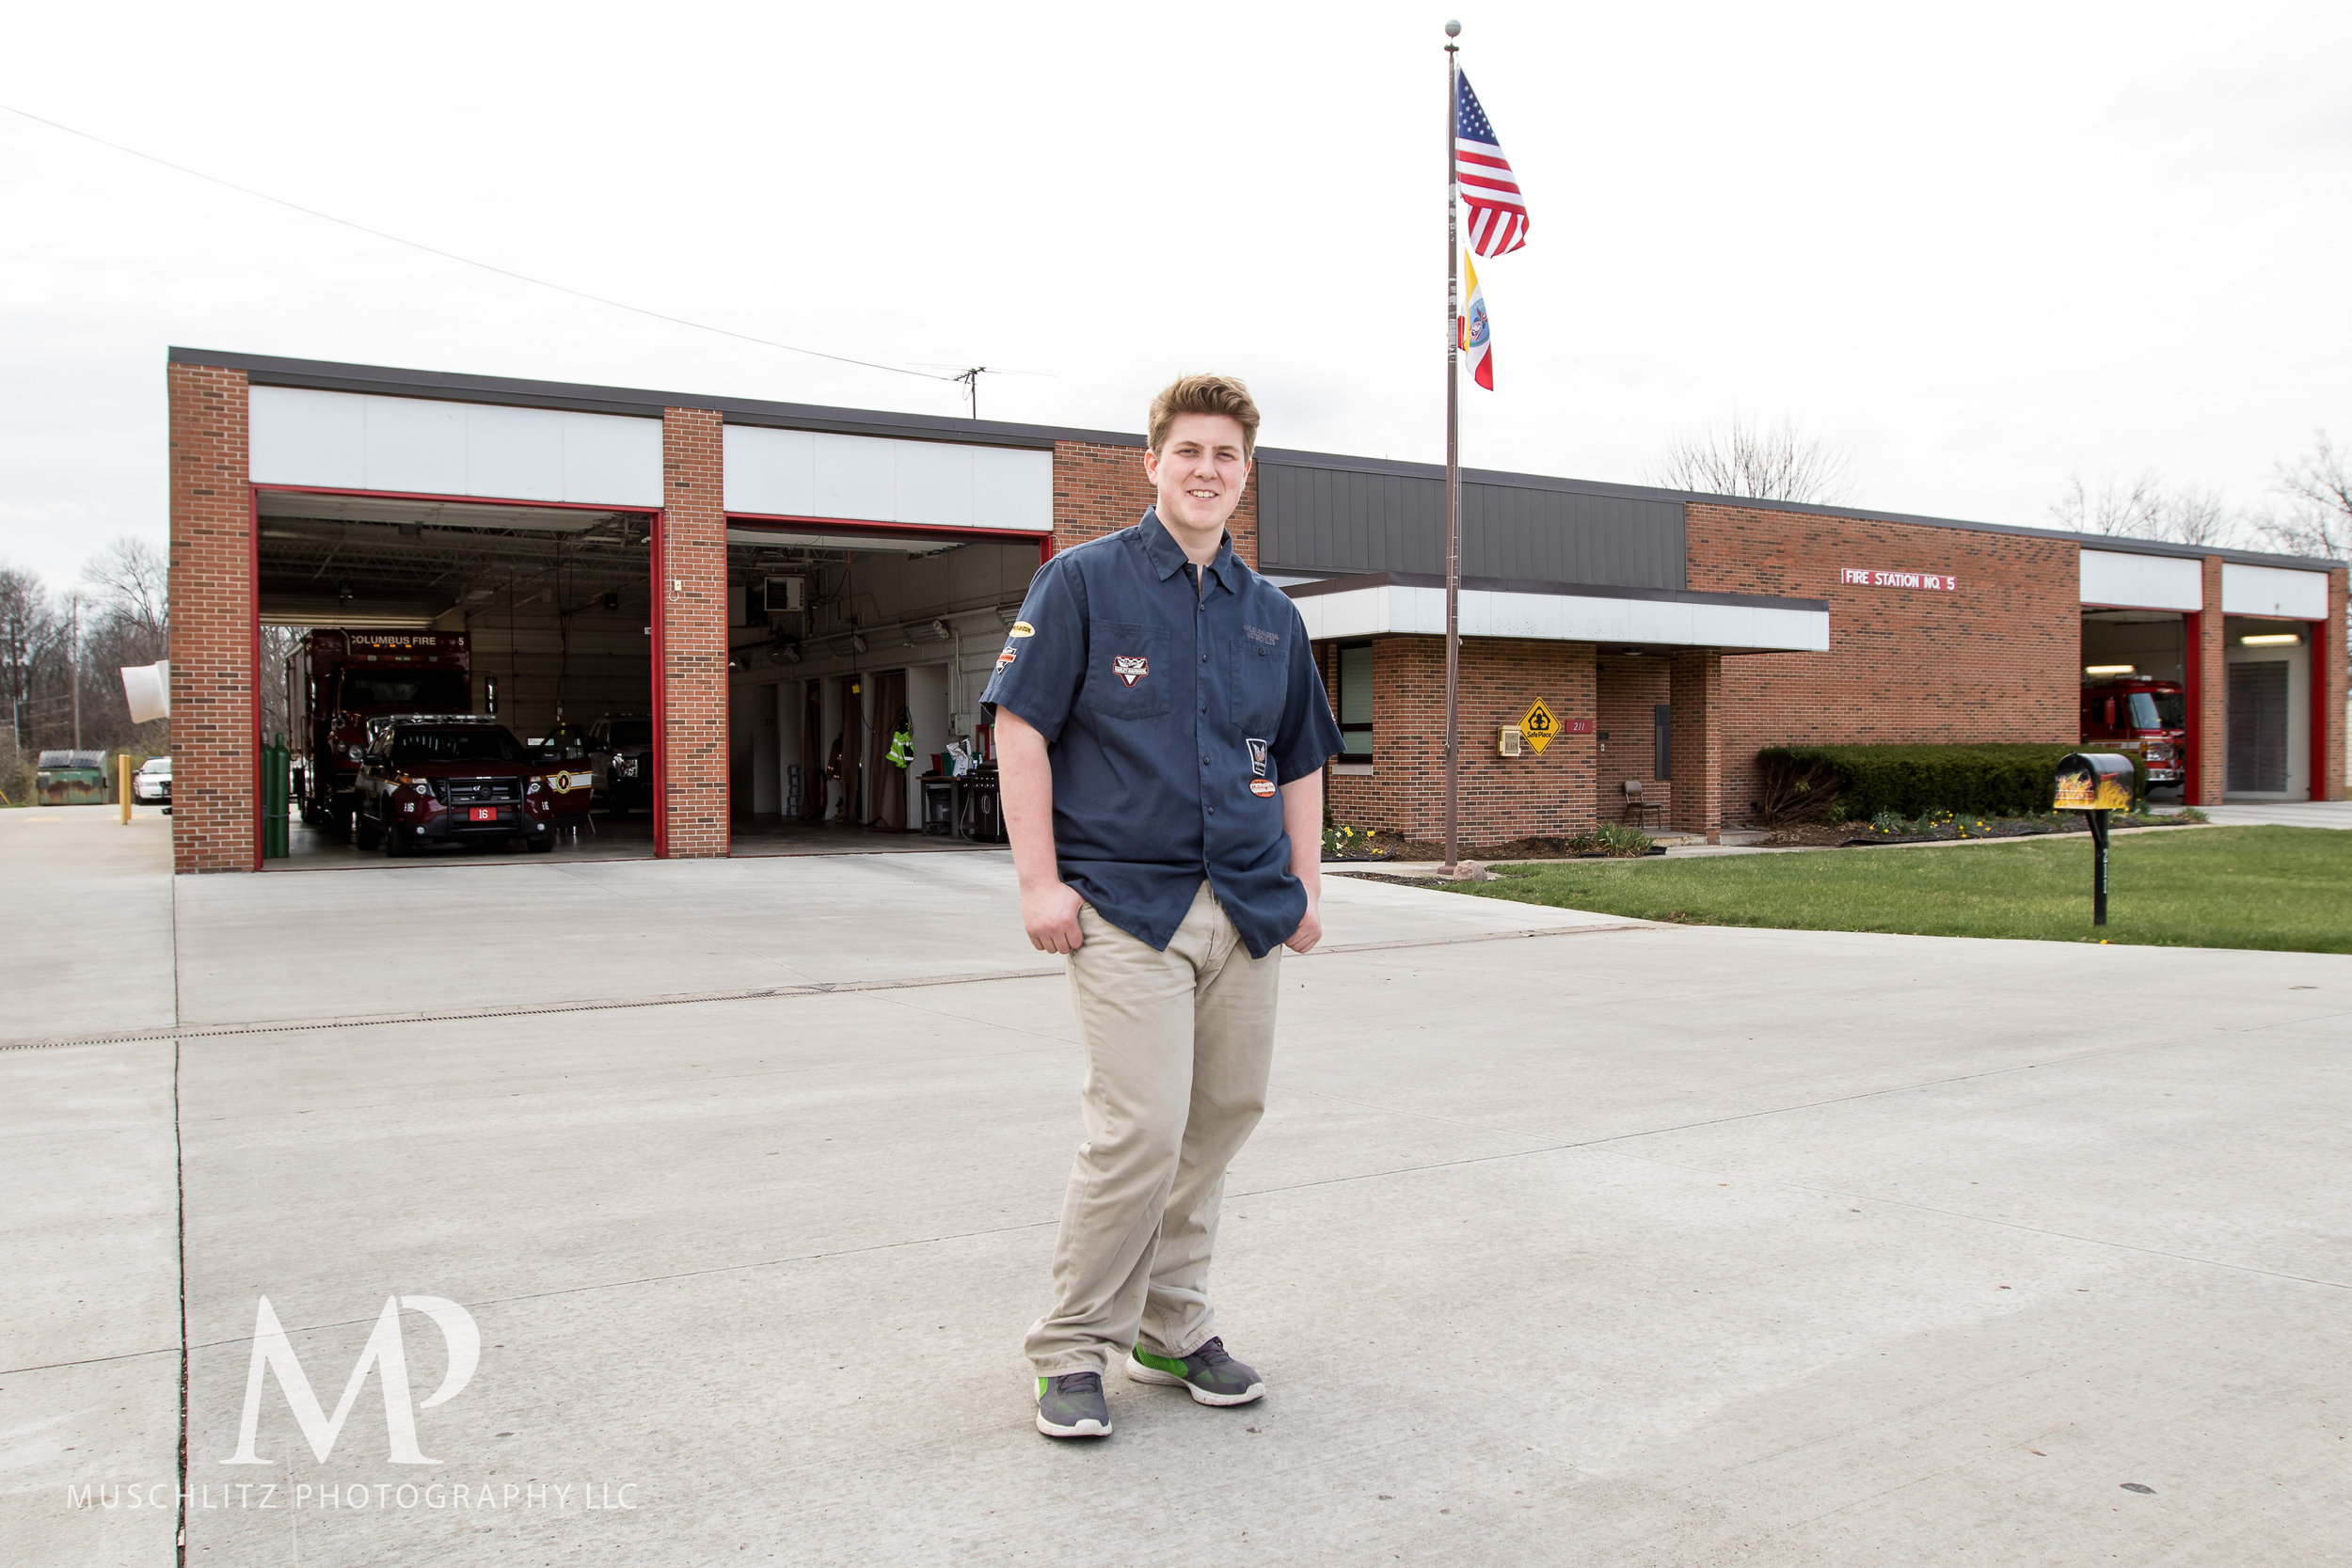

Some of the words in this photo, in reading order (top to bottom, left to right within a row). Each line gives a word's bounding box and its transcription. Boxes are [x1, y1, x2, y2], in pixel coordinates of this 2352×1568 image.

[1846, 570, 1868, 583] FIRE
[1874, 572, 1919, 588] STATION
[1924, 576, 1941, 590] NO.
[1947, 578, 1955, 591] 5
[412, 636, 437, 645] FIRE
[458, 637, 464, 646] 5
[1573, 721, 1585, 731] 211
[479, 809, 488, 819] 16
